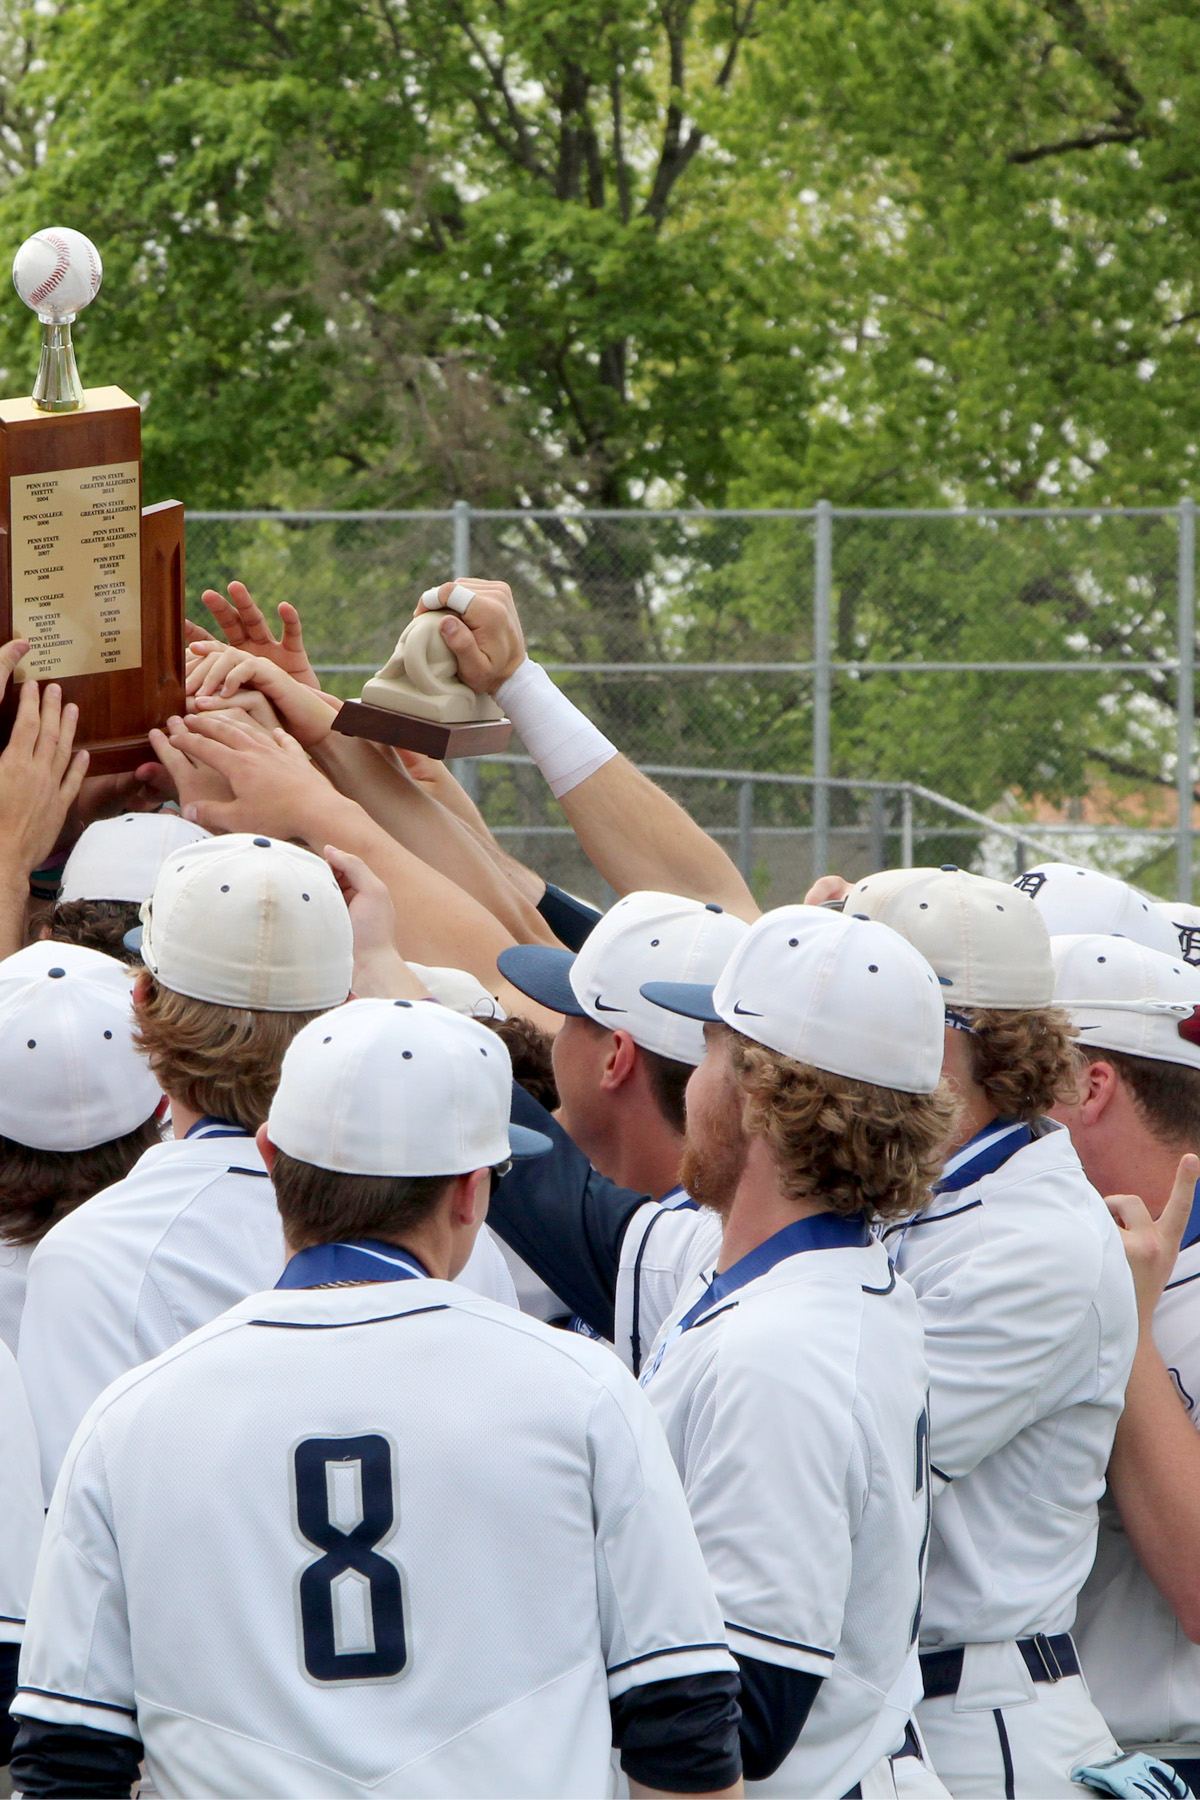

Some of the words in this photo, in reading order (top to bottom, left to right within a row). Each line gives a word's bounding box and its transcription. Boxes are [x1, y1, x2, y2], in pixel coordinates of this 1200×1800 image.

[105, 478, 136, 486] ALLEGHENY
[80, 509, 104, 517] GREATER
[106, 505, 137, 513] ALLEGHENY
[106, 532, 137, 541] ALLEGHENY
[42, 640, 73, 648] ALLEGHENY
[288, 1429, 414, 1688] 8
